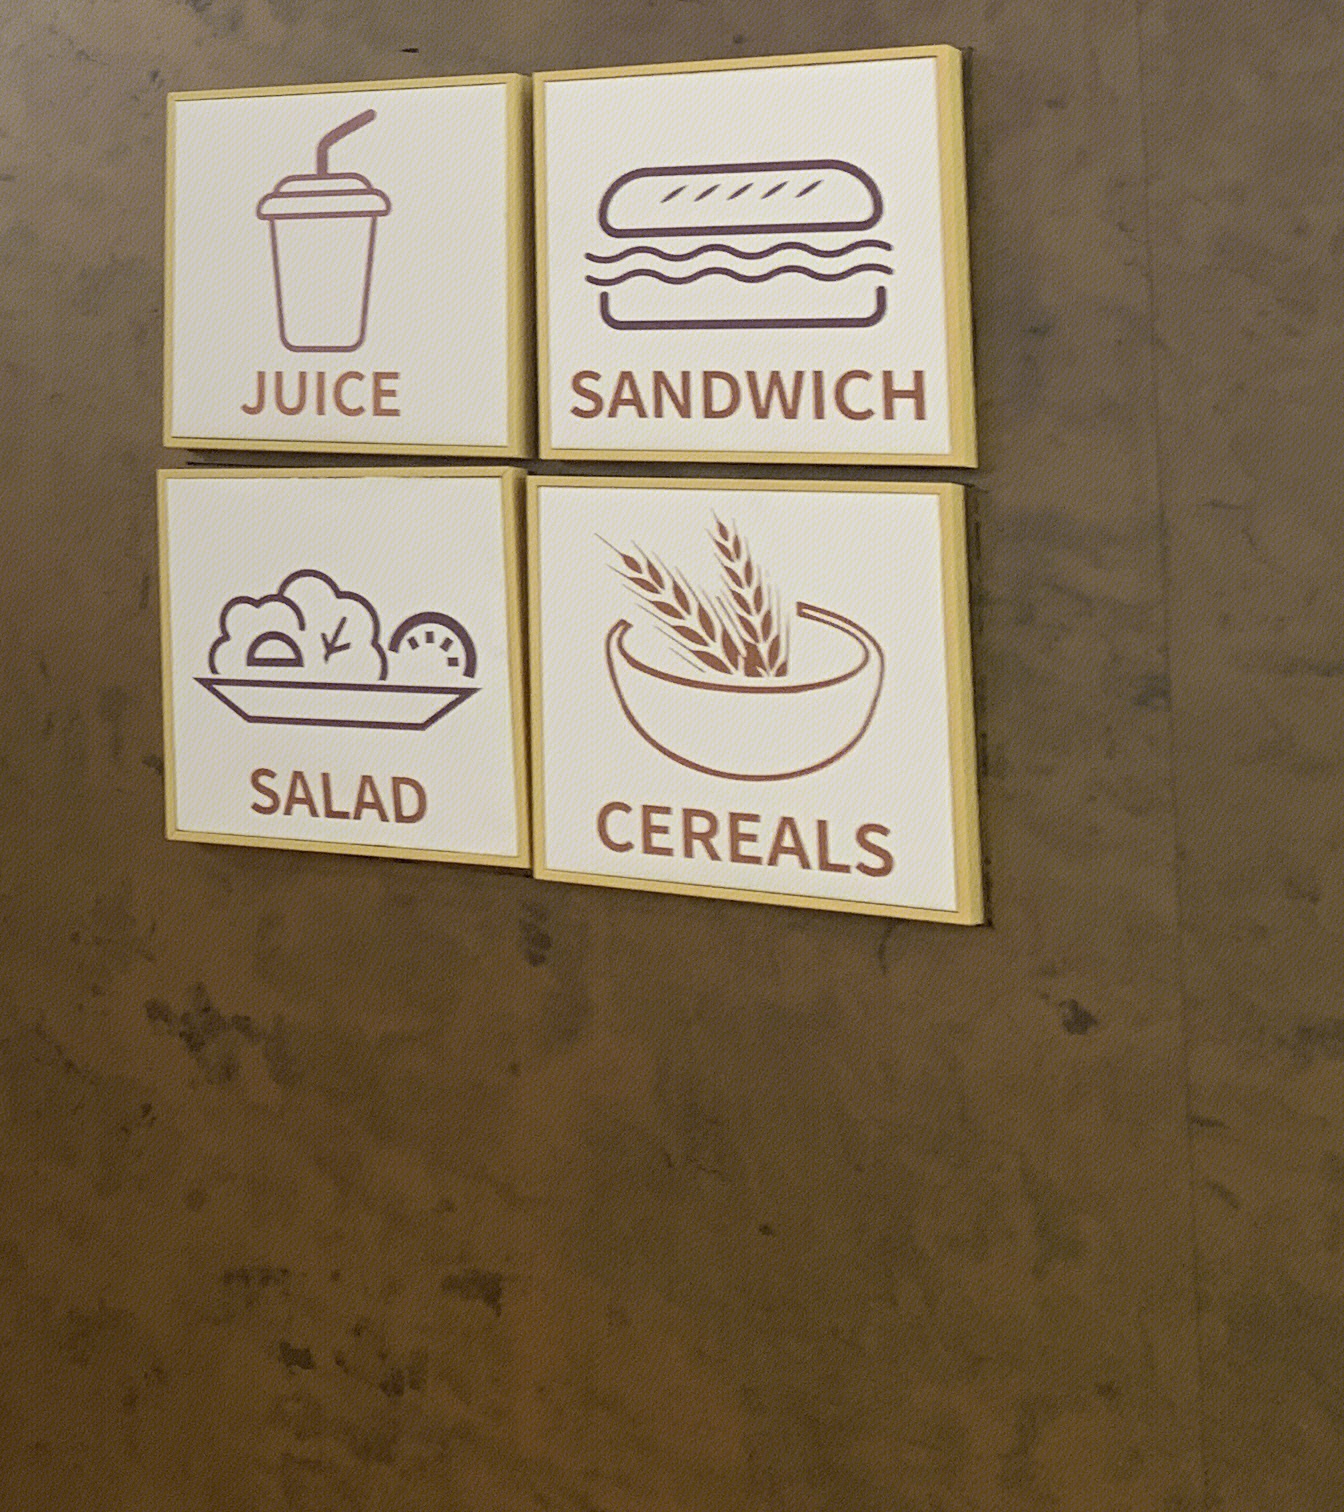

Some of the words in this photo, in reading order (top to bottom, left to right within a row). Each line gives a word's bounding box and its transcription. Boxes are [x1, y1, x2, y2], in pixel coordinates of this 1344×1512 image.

[241, 369, 401, 418] JUICE
[570, 368, 927, 421] SANDWICH
[250, 767, 428, 825] SALAD
[596, 800, 895, 879] CEREALS
